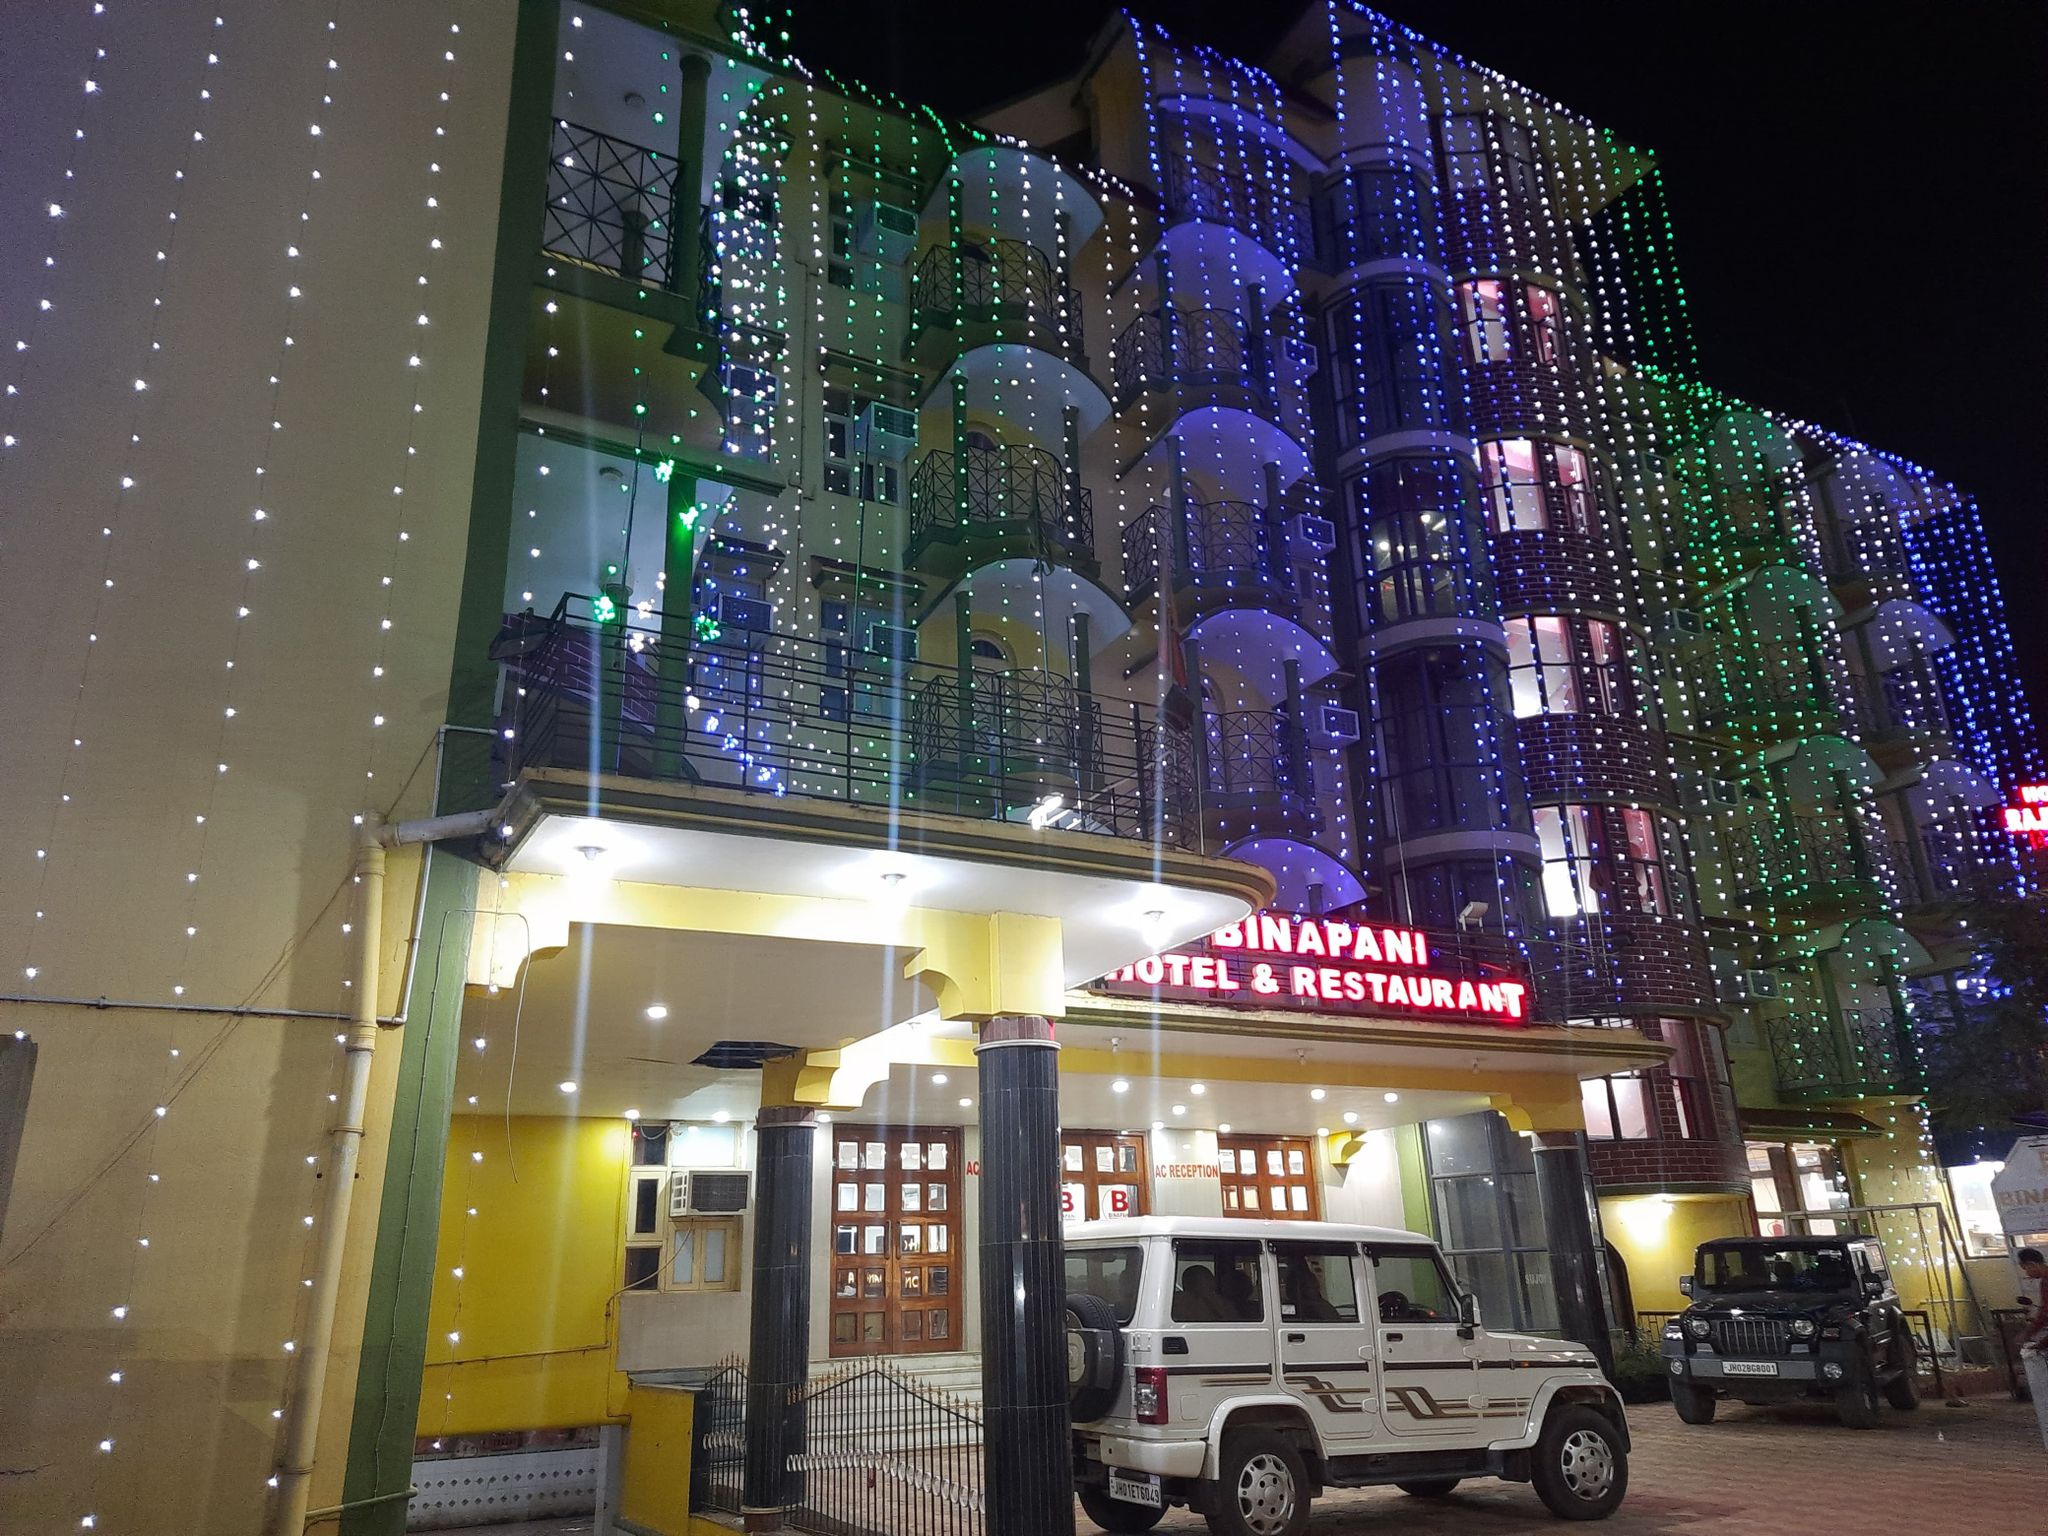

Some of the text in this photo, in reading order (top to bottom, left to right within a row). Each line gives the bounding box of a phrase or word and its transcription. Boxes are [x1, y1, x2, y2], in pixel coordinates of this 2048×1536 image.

[1211, 914, 1429, 967] BINAPANI
[1251, 962, 1279, 995] &
[1290, 966, 1526, 1019] RESTAURANT
[1155, 1164, 1219, 1178] AC RECEPTION
[1111, 1190, 1129, 1212] B
